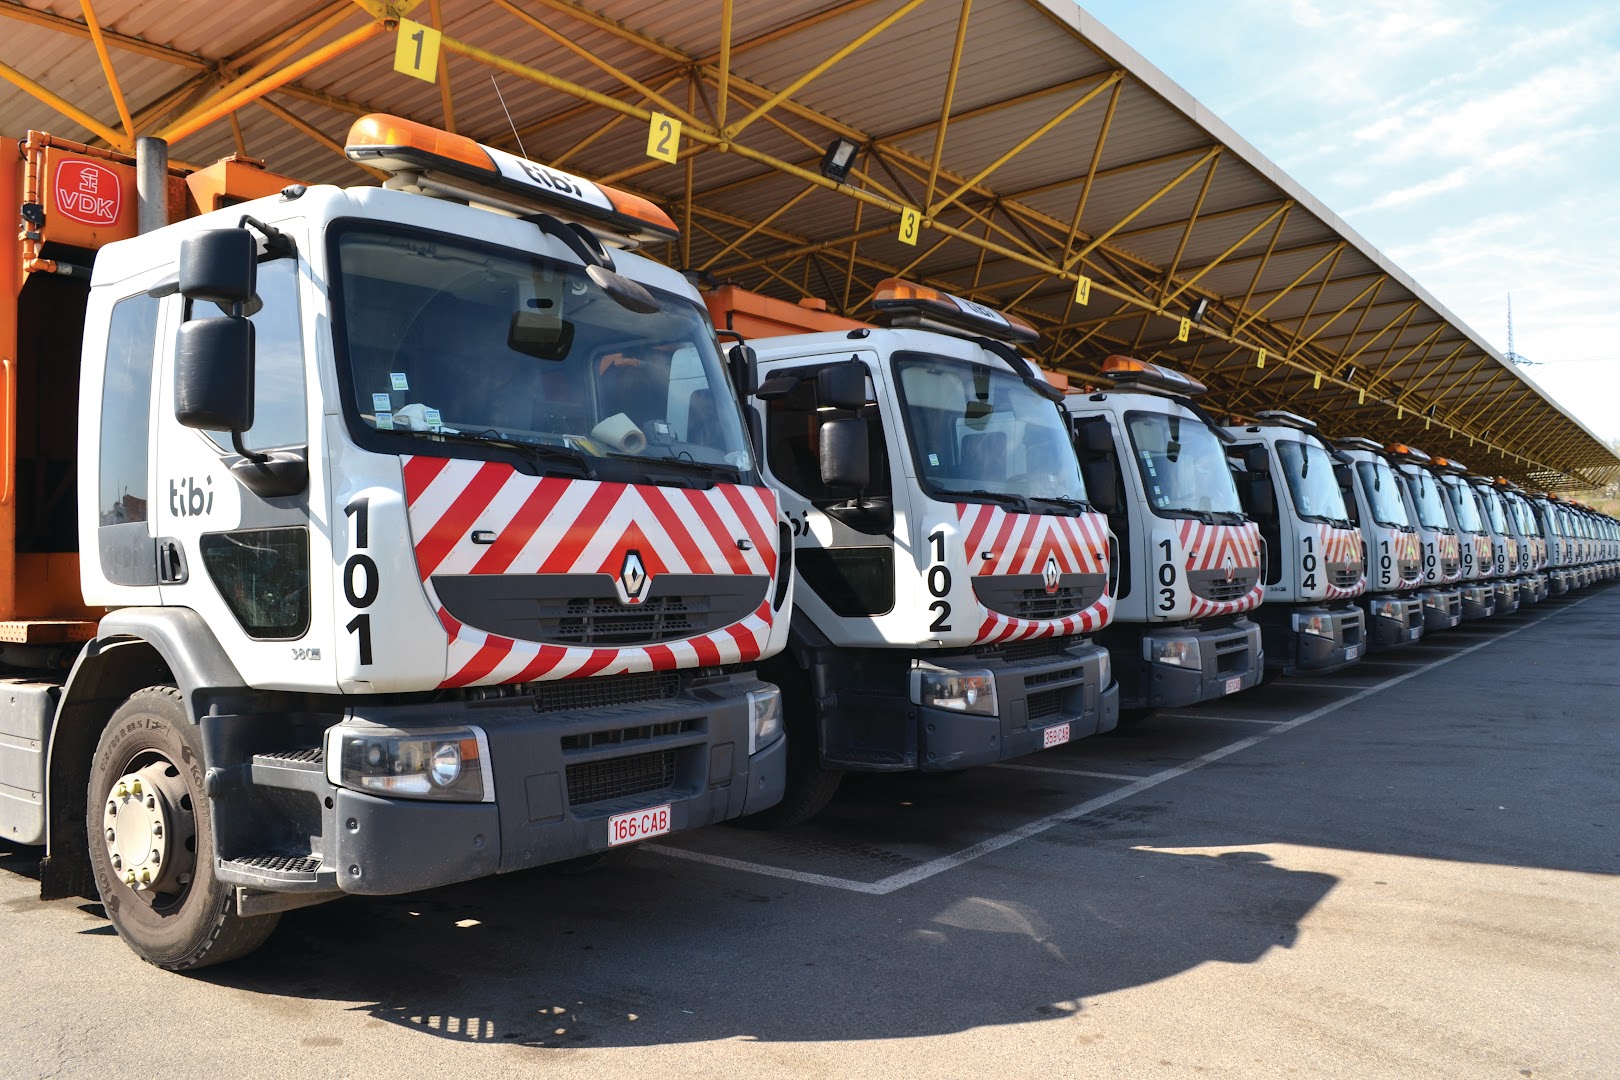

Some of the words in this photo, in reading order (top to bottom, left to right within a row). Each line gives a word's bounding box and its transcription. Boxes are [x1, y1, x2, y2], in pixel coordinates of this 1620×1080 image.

[412, 30, 424, 70] 1
[656, 120, 672, 155] 2
[515, 160, 583, 198] tibi
[60, 188, 114, 219] VDK
[905, 212, 915, 239] 3
[1081, 279, 1087, 300] 4
[1182, 320, 1188, 338] 5
[169, 474, 214, 517] tibi
[1158, 538, 1177, 612] 103
[1302, 536, 1317, 591] 104
[1380, 540, 1392, 585] 105
[1426, 542, 1436, 581] 106
[1464, 542, 1473, 576] 107
[1497, 544, 1506, 574] 108
[343, 497, 379, 666] 101
[927, 530, 952, 633] 102
